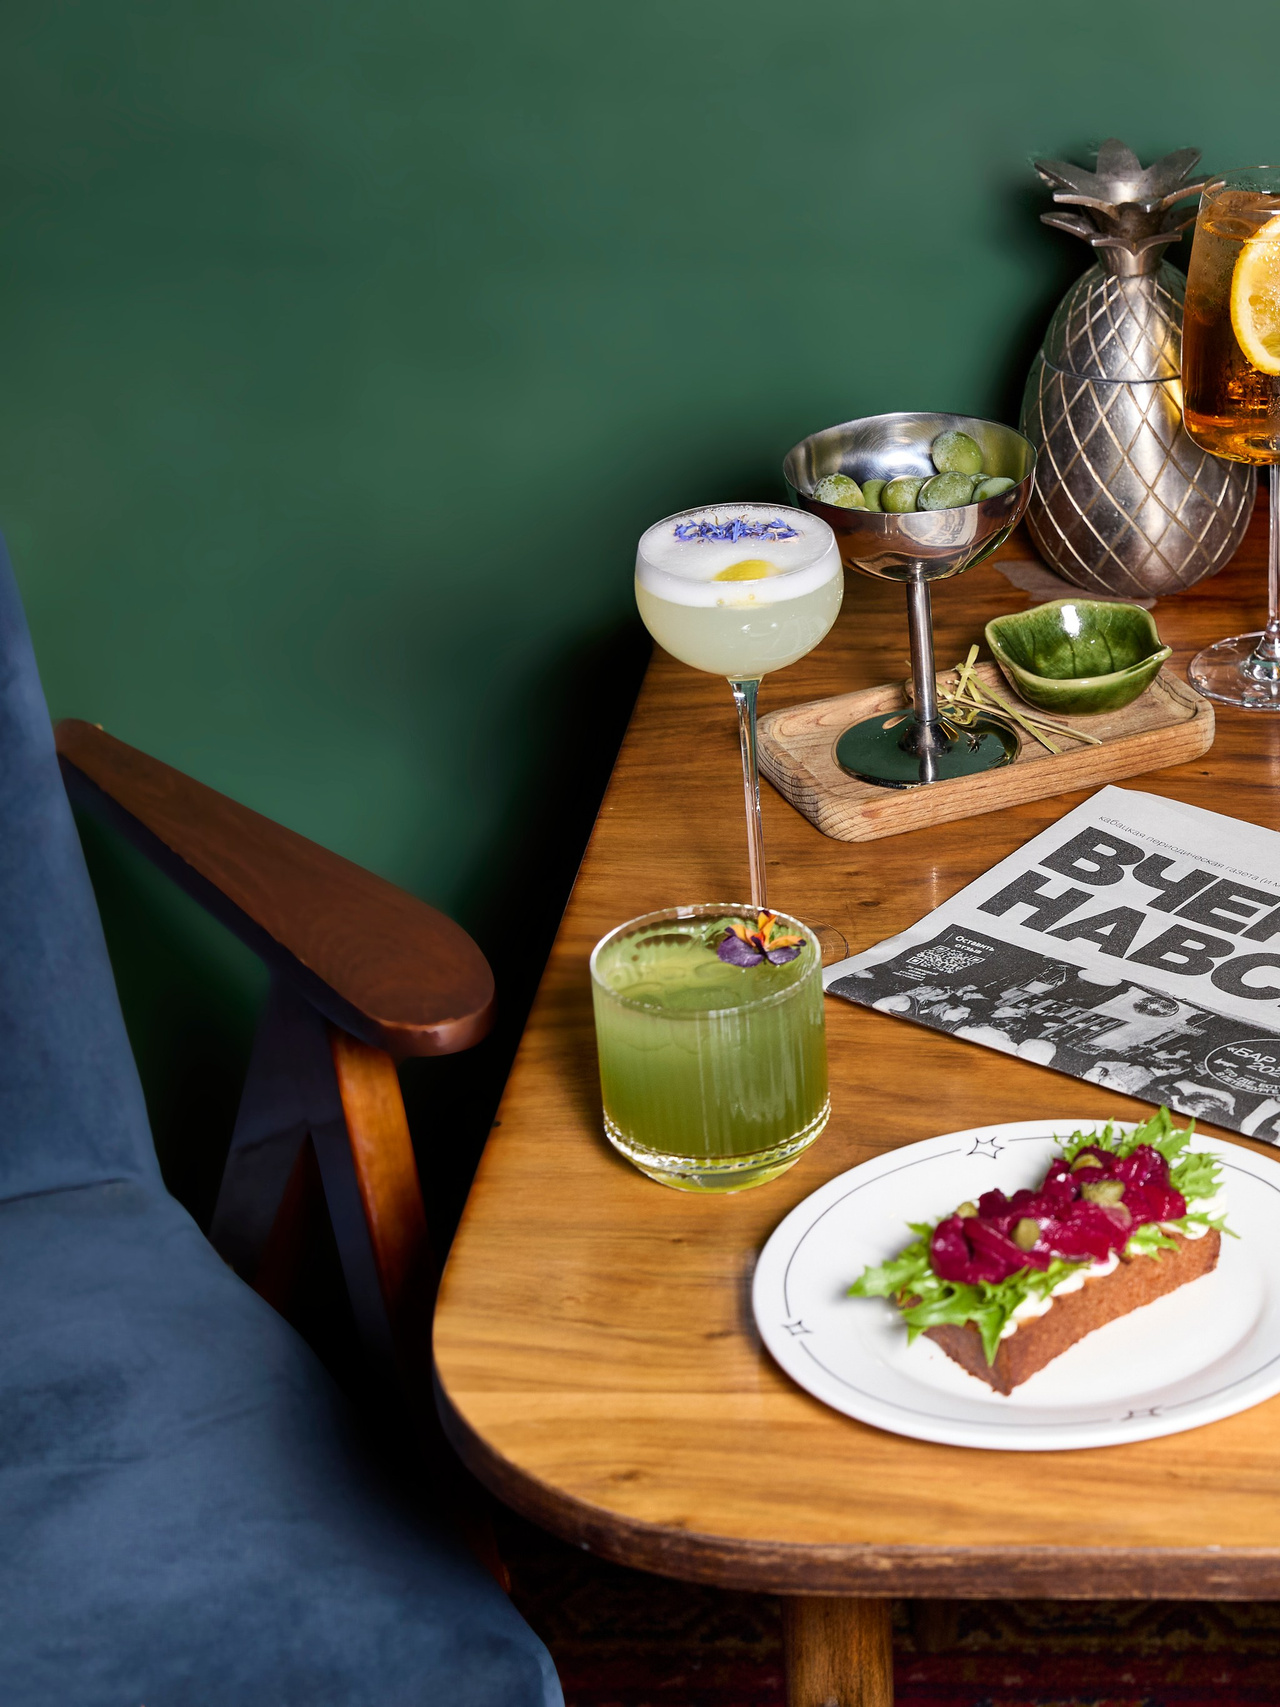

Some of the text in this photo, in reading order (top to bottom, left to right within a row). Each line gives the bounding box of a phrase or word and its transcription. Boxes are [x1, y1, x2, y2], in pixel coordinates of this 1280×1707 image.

[1098, 815, 1145, 839] кабацкая
[1147, 836, 1225, 869] периодическая
[1225, 864, 1259, 882] газета
[1260, 874, 1272, 886] (и
[955, 935, 995, 952] Оставить
[955, 943, 983, 954] отзыв
[1226, 1046, 1277, 1063] «БАР
